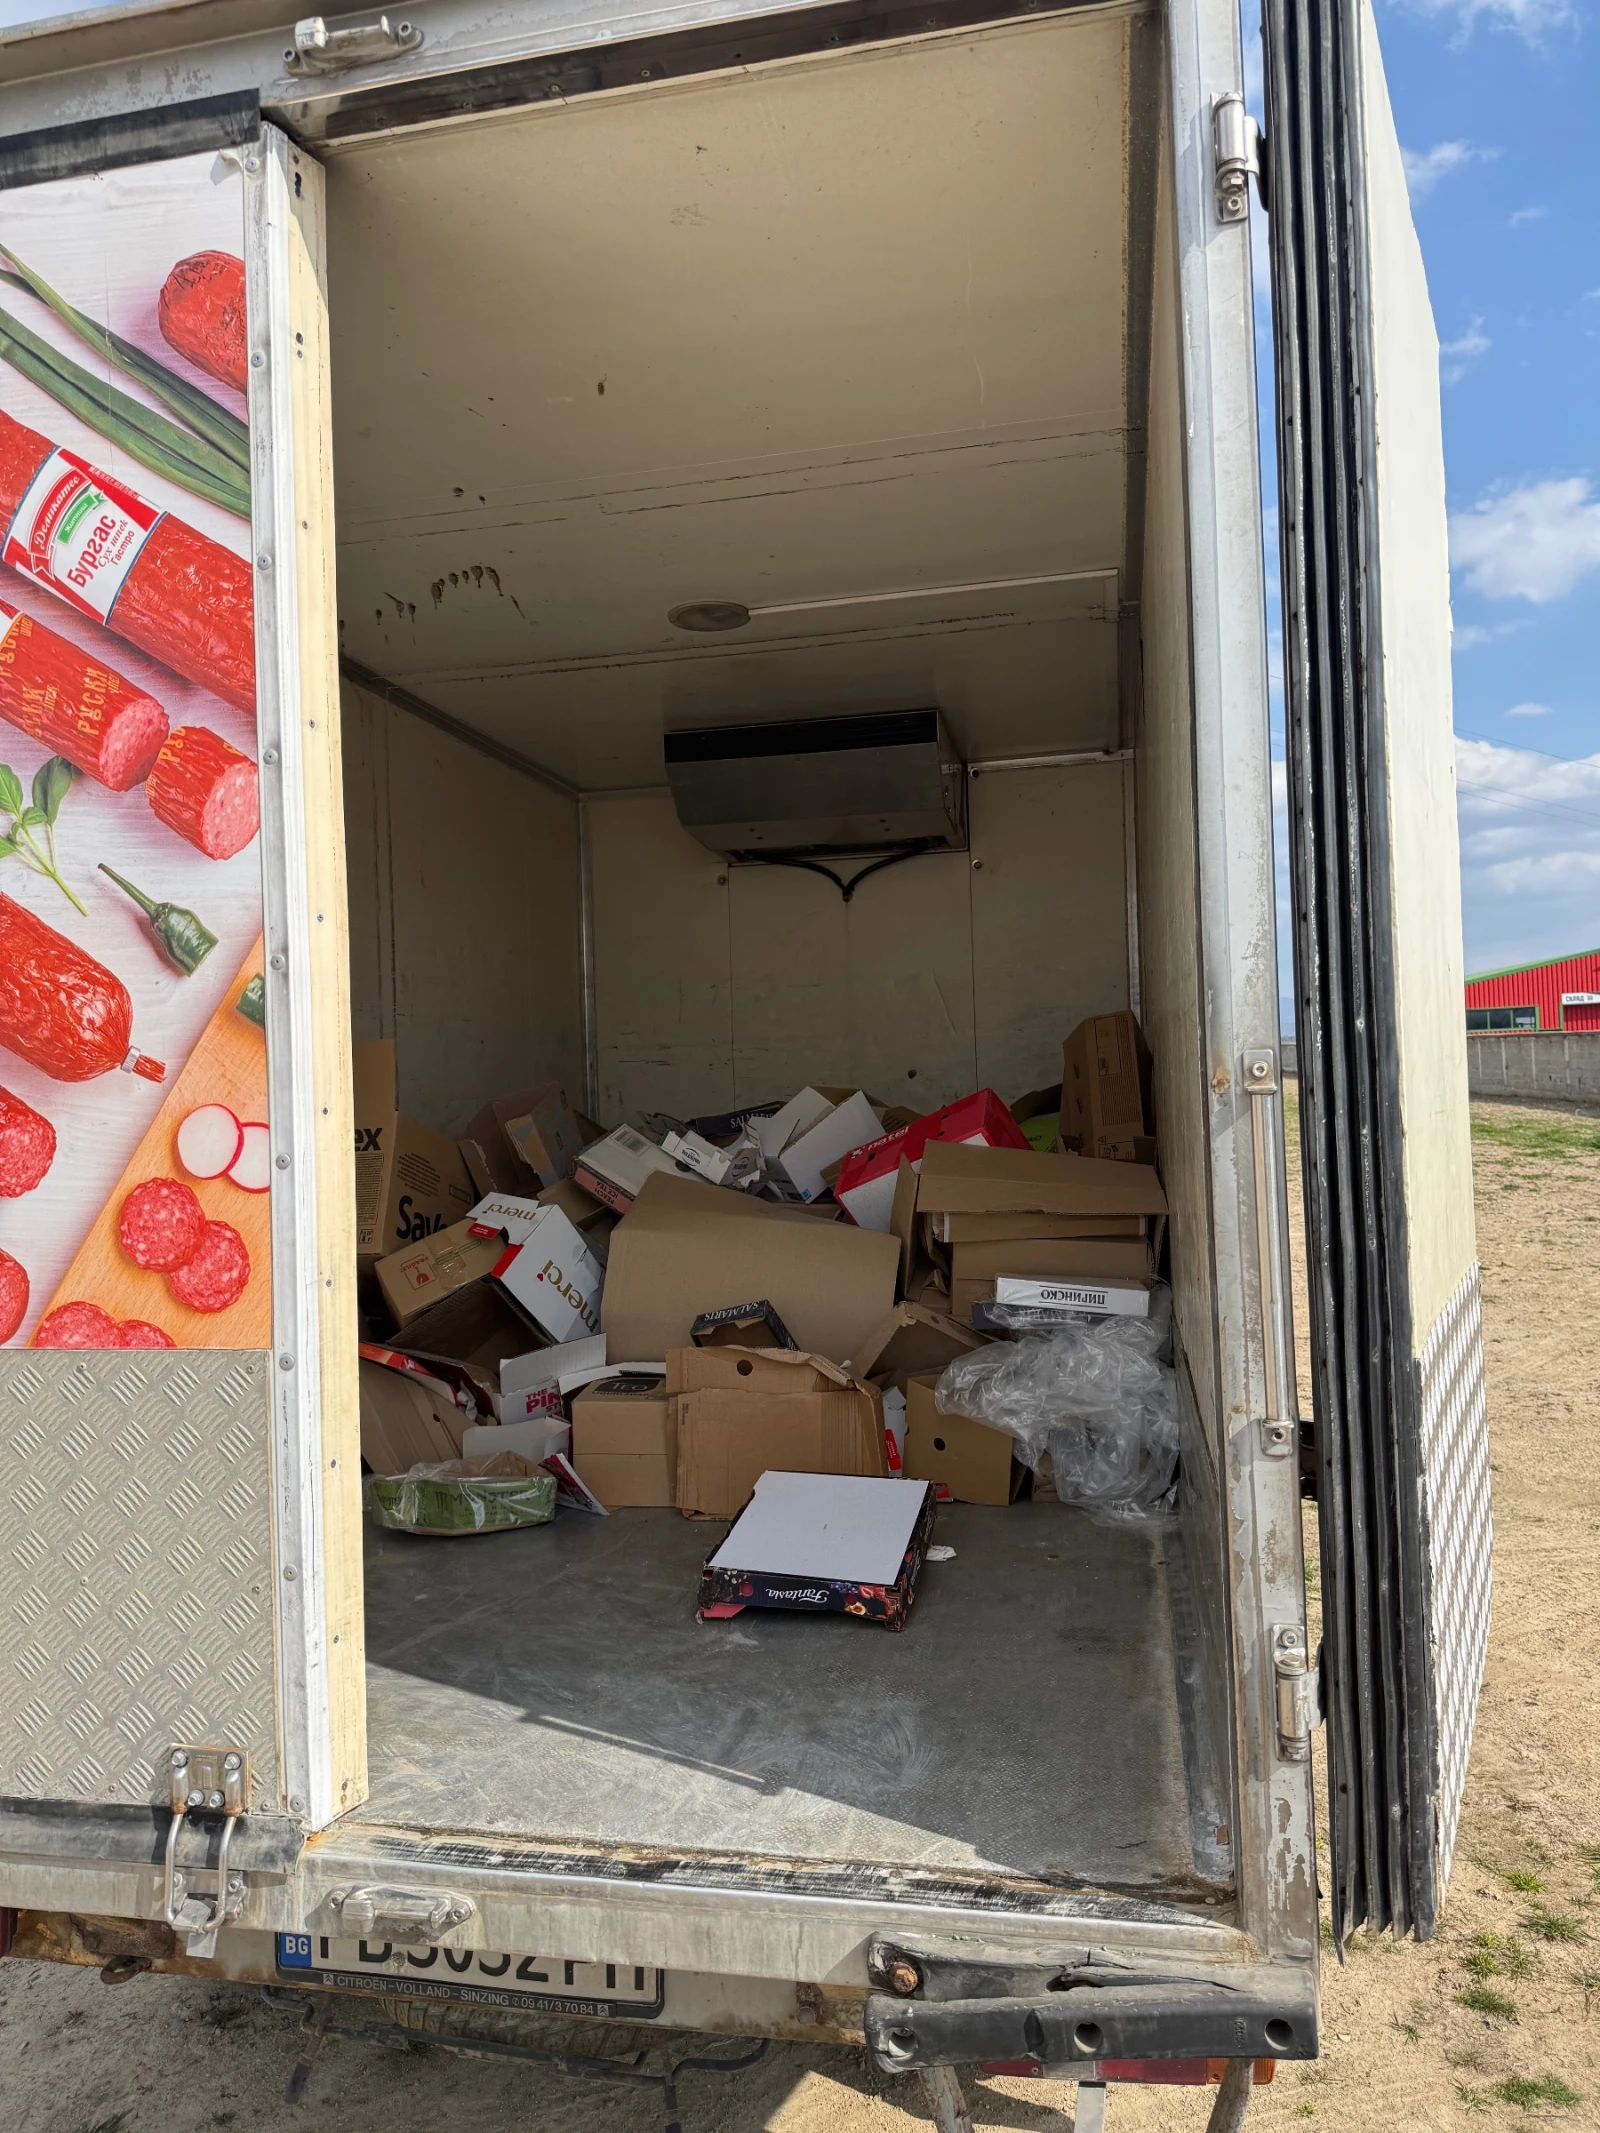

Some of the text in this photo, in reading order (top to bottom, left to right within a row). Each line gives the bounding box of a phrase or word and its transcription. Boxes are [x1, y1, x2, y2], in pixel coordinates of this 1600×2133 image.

[66, 514, 117, 589] Бургас
[110, 530, 135, 566] Гастро
[482, 1203, 537, 1222] merci
[537, 1259, 598, 1333] merci
[1040, 1288, 1105, 1305] ПИРИНСКО
[704, 1301, 760, 1320] SALMARIS
[525, 1388, 548, 1401] THE
[612, 1382, 648, 1391] TEO
[765, 1588, 830, 1604] Fantasia
[285, 1936, 309, 1956] BG
[460, 1989, 509, 2006] SINZING
